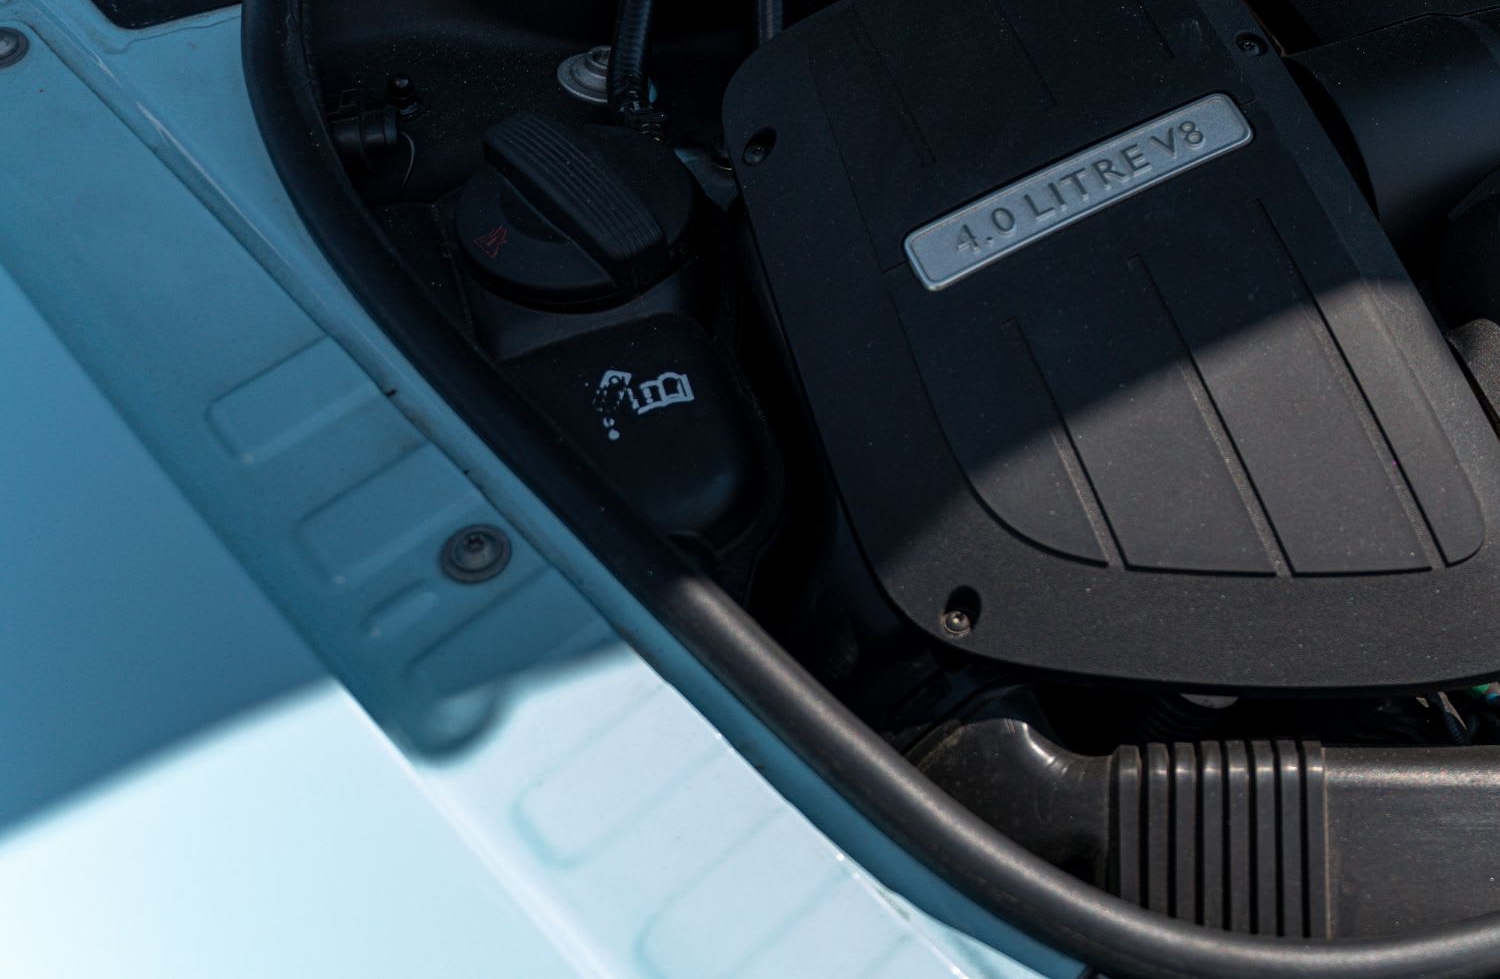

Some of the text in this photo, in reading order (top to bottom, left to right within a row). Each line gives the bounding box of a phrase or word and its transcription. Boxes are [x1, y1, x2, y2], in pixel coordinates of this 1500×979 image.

[956, 120, 1205, 254] 4.0 LITRE V8
